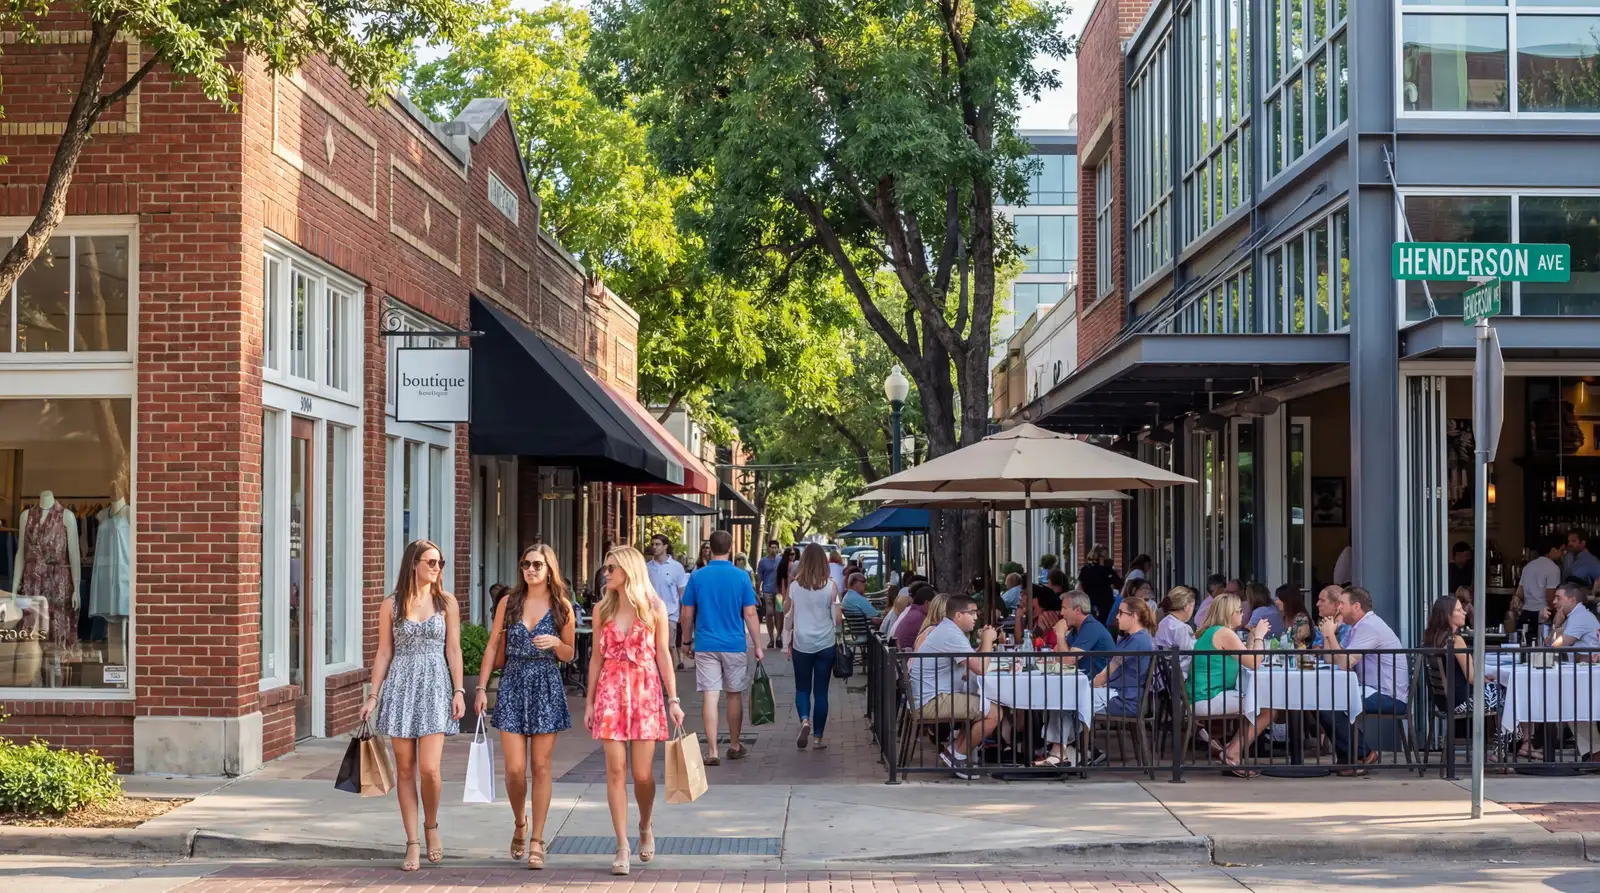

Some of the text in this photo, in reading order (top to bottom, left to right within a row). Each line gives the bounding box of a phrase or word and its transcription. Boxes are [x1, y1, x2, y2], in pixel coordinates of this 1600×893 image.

[1400, 248, 1564, 276] HENDERSON AVE
[402, 372, 465, 391] boutique
